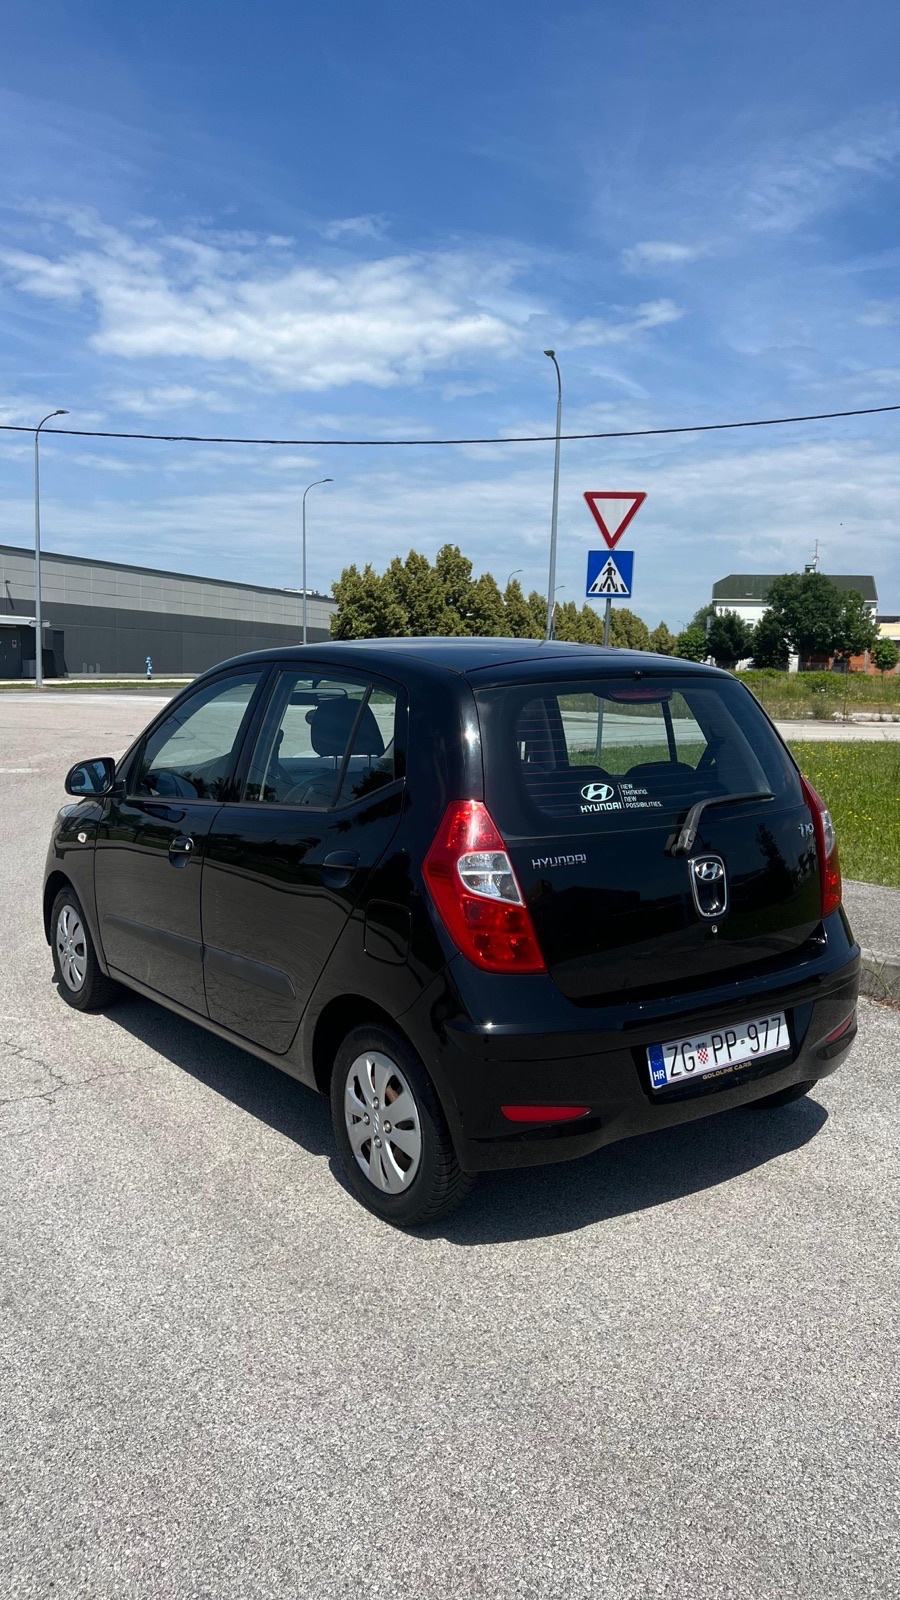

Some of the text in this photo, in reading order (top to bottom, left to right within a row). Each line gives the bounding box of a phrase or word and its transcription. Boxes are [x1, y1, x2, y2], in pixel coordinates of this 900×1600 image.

[580, 802, 622, 813] HYUNDAI
[531, 853, 587, 869] HYUNDAI
[667, 1042, 696, 1078] ZG
[653, 1069, 666, 1081] HR
[702, 1061, 753, 1080] GOLDLINE CARS
